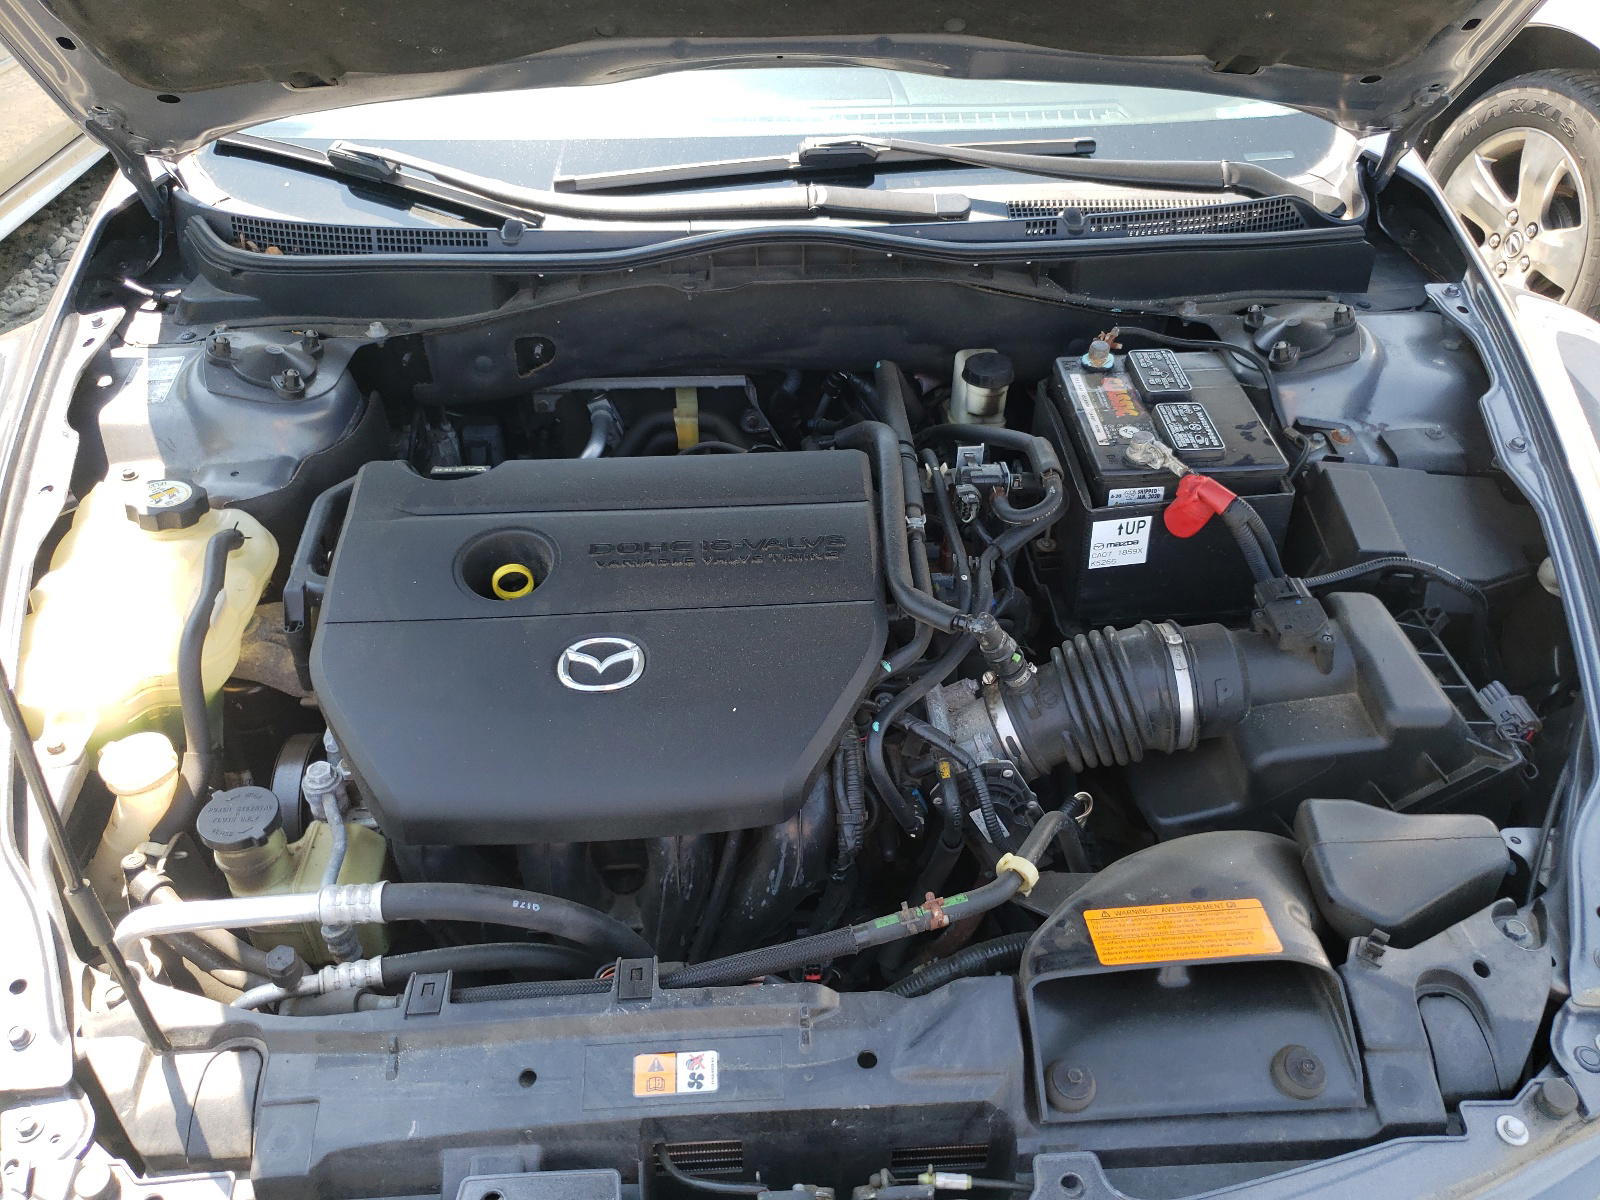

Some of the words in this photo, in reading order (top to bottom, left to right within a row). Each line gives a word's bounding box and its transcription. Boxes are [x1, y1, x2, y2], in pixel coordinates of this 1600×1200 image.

[1461, 98, 1578, 138] MAXXIS
[1126, 519, 1146, 535] UP
[588, 540, 693, 556] DOHC
